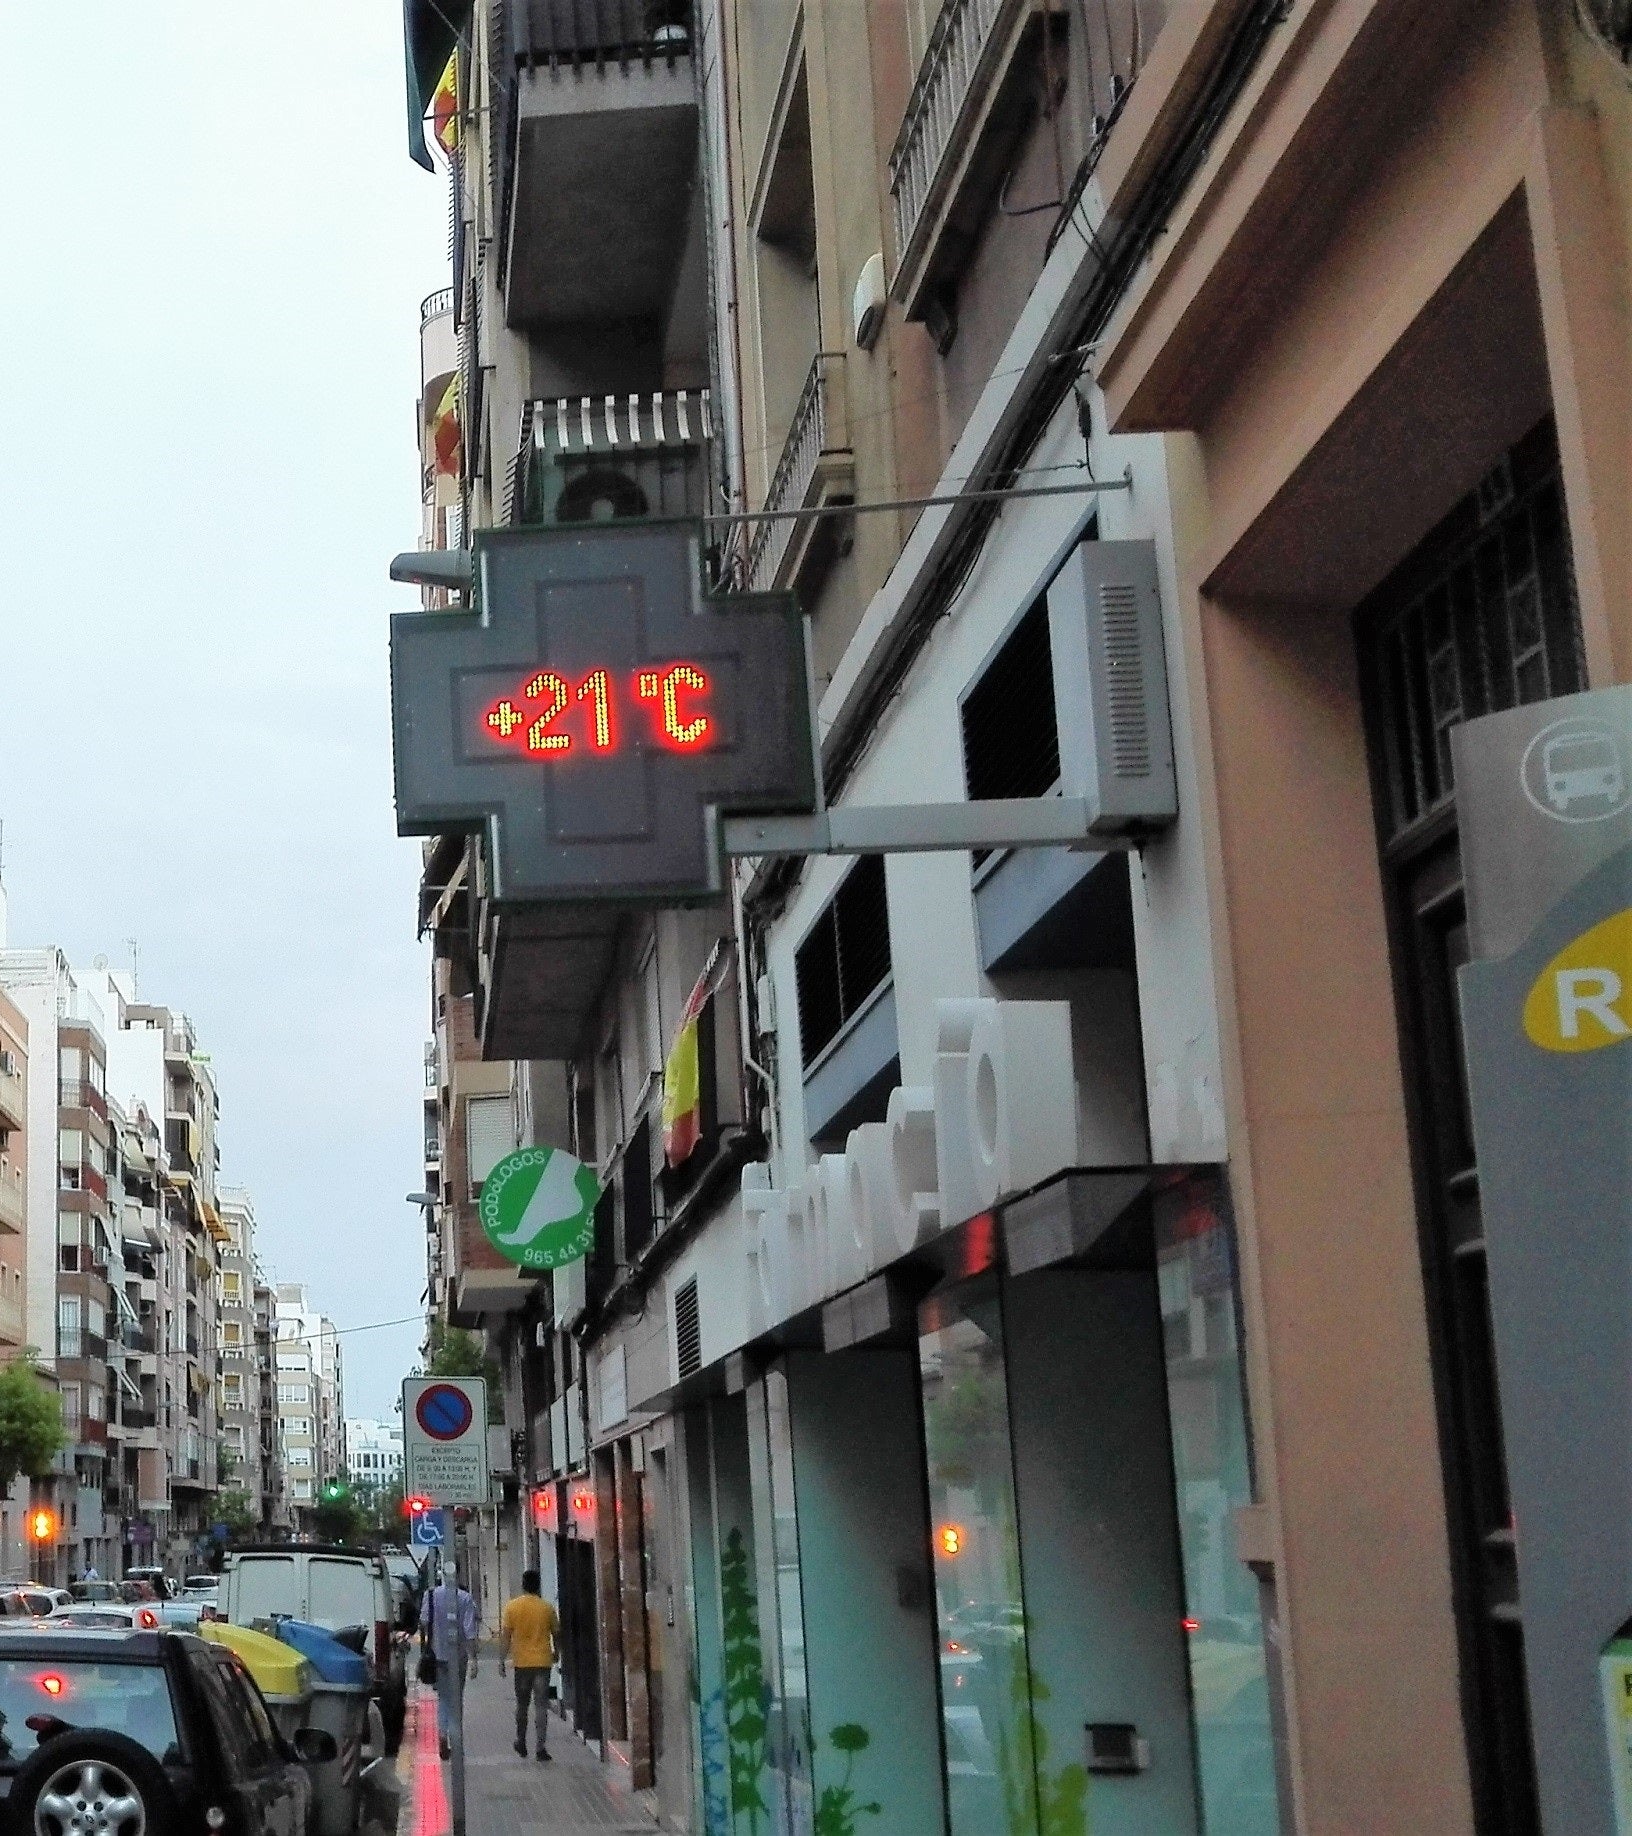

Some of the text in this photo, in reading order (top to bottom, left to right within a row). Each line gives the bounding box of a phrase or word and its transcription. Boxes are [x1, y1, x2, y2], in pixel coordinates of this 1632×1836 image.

[1555, 967, 1632, 1039] R
[524, 1247, 554, 1264] 965
[559, 1243, 577, 1260] 44
